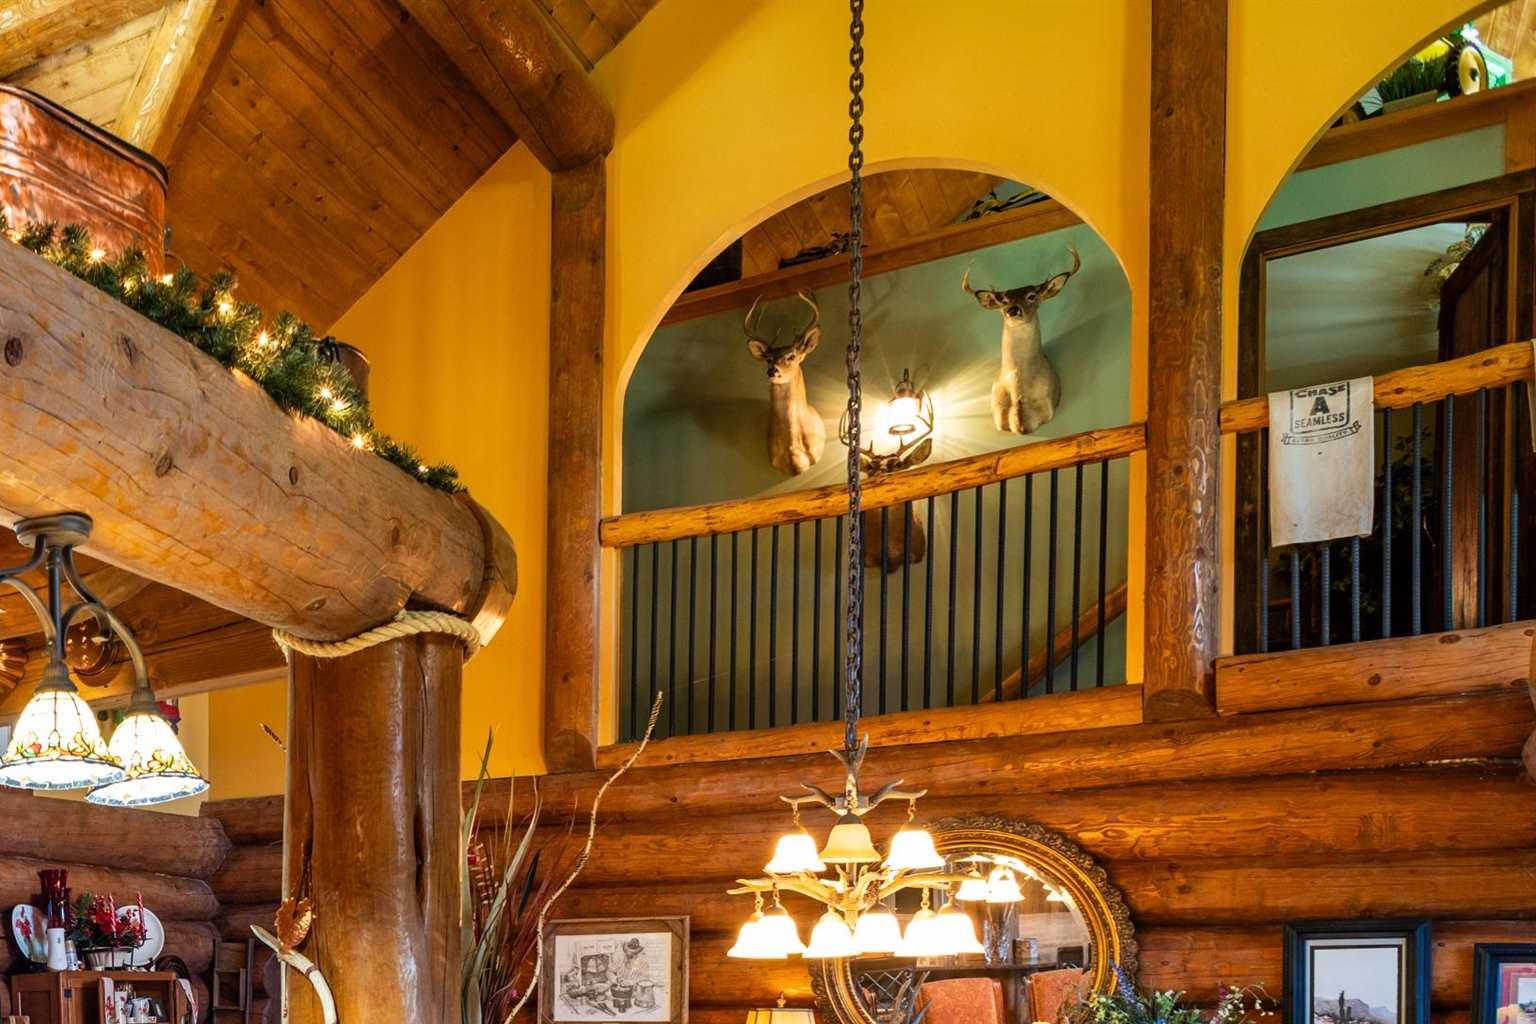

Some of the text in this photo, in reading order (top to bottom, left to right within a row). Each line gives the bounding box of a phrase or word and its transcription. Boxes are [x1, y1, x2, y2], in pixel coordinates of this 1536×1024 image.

[1295, 384, 1346, 398] CHASE
[1310, 396, 1330, 416] A
[1294, 412, 1345, 429] SEAMLESS
